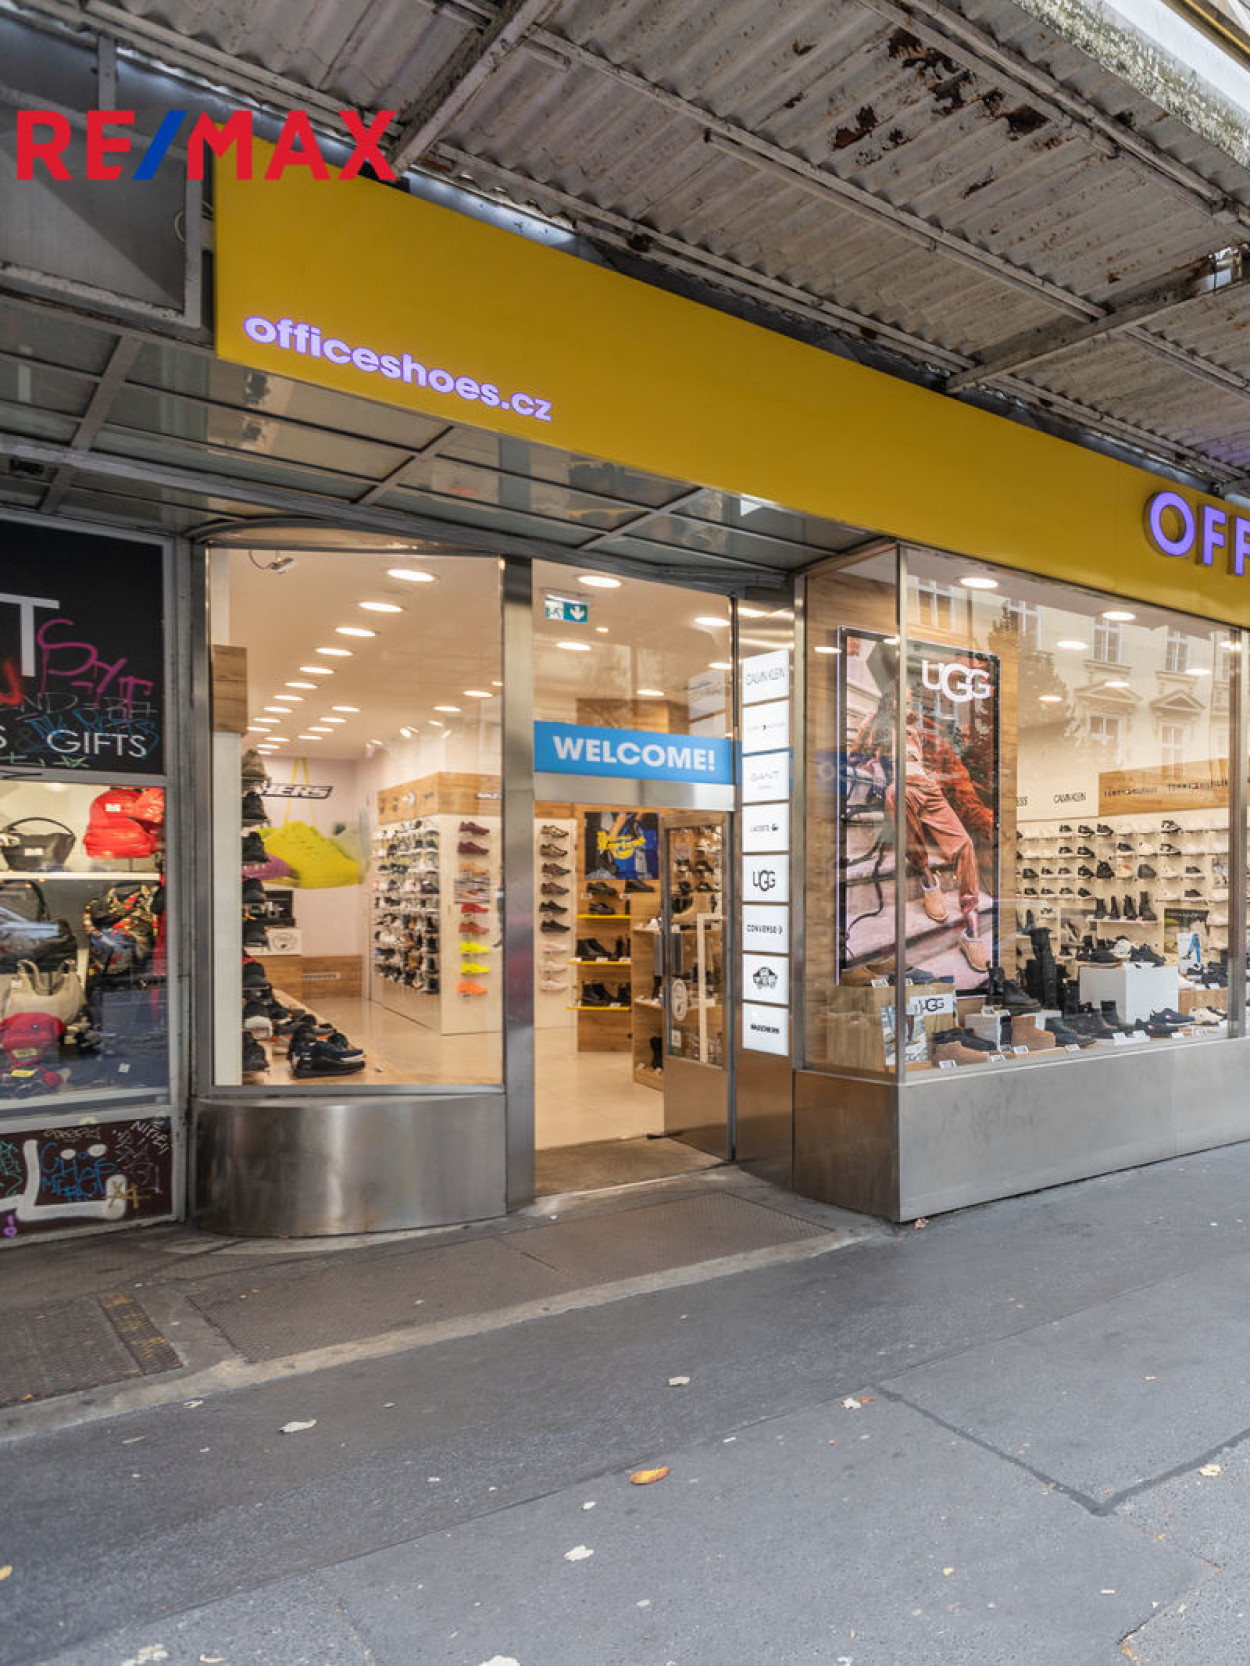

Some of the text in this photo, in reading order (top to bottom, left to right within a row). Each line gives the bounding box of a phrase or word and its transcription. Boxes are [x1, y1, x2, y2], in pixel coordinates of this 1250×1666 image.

[243, 315, 553, 422] officeshoes.cz
[921, 659, 992, 703] UGG
[46, 729, 148, 759] GIFTS
[552, 735, 716, 773] WELCOME!
[752, 869, 776, 892] UGG
